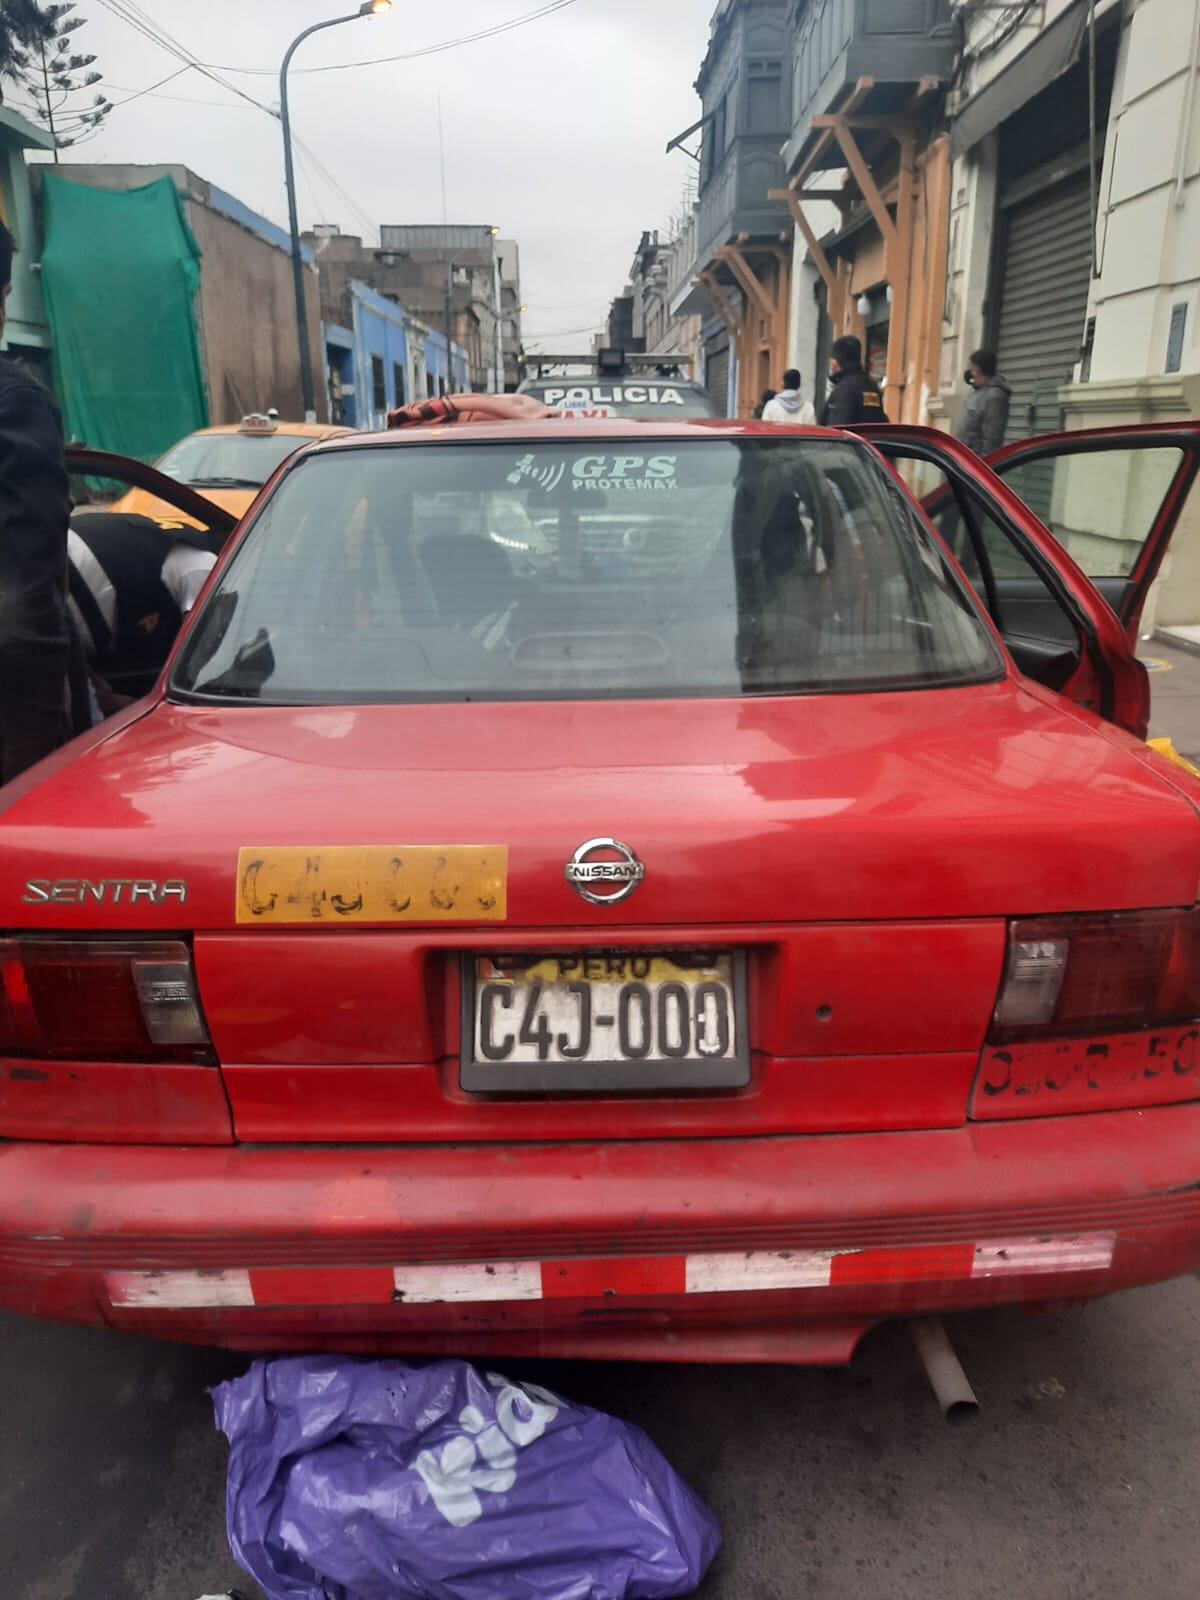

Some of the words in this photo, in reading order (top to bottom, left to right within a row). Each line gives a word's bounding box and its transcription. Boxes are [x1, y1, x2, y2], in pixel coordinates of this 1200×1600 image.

[544, 387, 684, 405] POLICIA
[571, 456, 677, 478] GPS
[572, 479, 678, 490] PROTEMAX
[574, 866, 637, 876] NISSAN
[23, 879, 188, 904] SENTRA
[479, 981, 729, 1060] C4J-000
